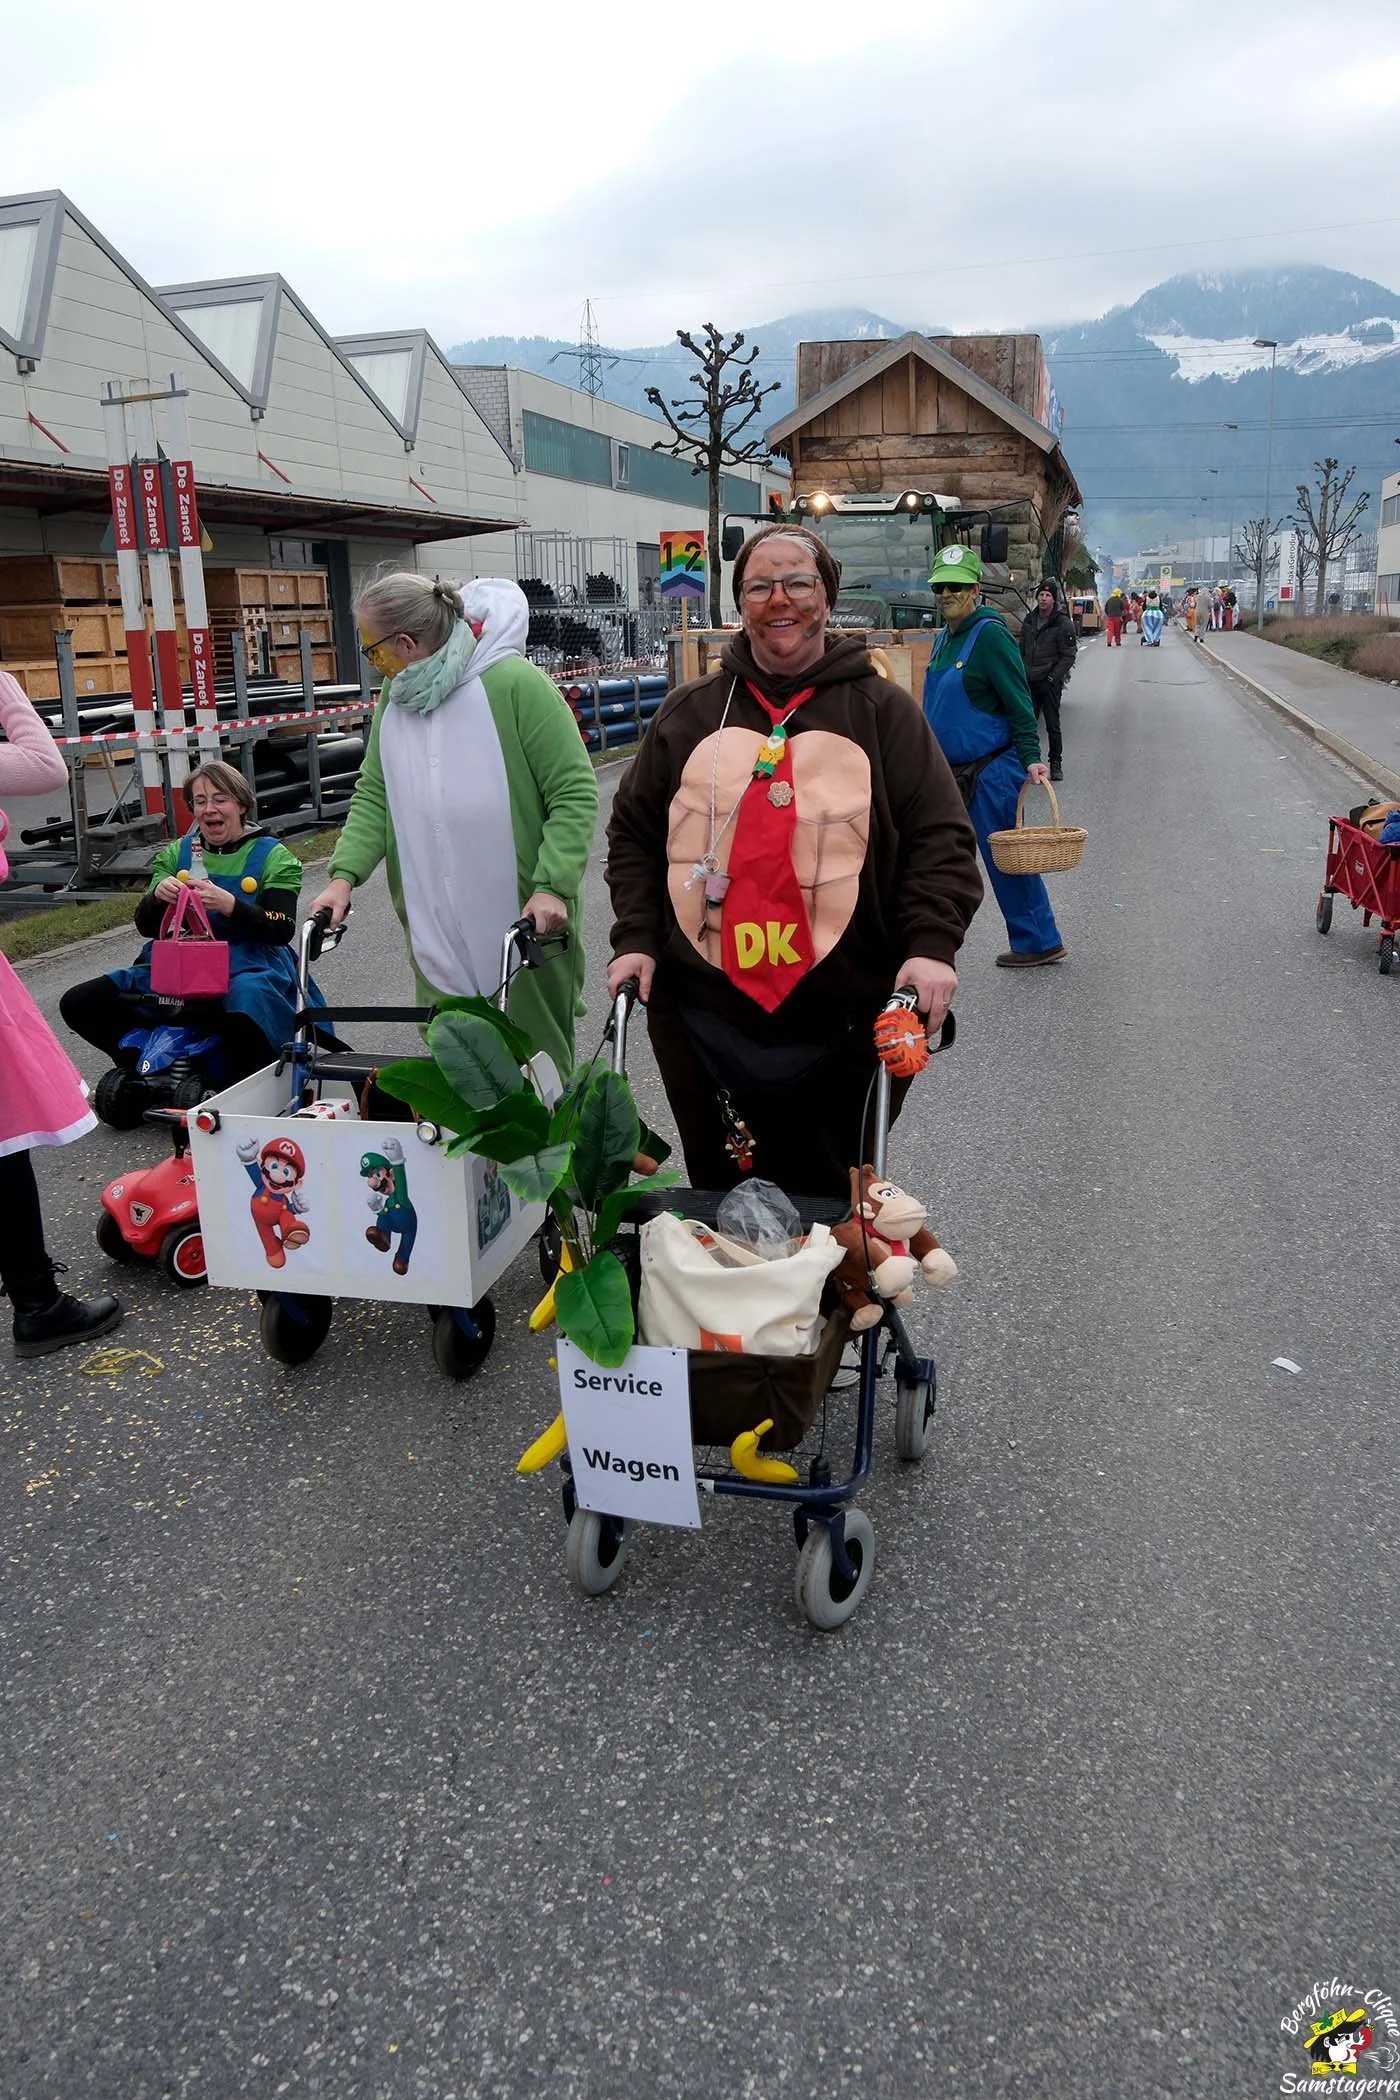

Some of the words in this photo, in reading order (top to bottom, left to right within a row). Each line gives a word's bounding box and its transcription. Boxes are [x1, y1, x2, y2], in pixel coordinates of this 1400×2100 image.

[113, 469, 124, 492] De
[143, 469, 154, 492] De
[176, 466, 187, 489] De
[116, 497, 130, 545] Zanet
[146, 496, 160, 545] Zanet
[179, 493, 193, 542] Zanet
[663, 541, 702, 572] 12
[192, 633, 204, 655] De
[195, 660, 209, 706] Zanet
[734, 920, 802, 969] DK
[573, 1368, 663, 1397] Service
[582, 1447, 680, 1482] Wagen
